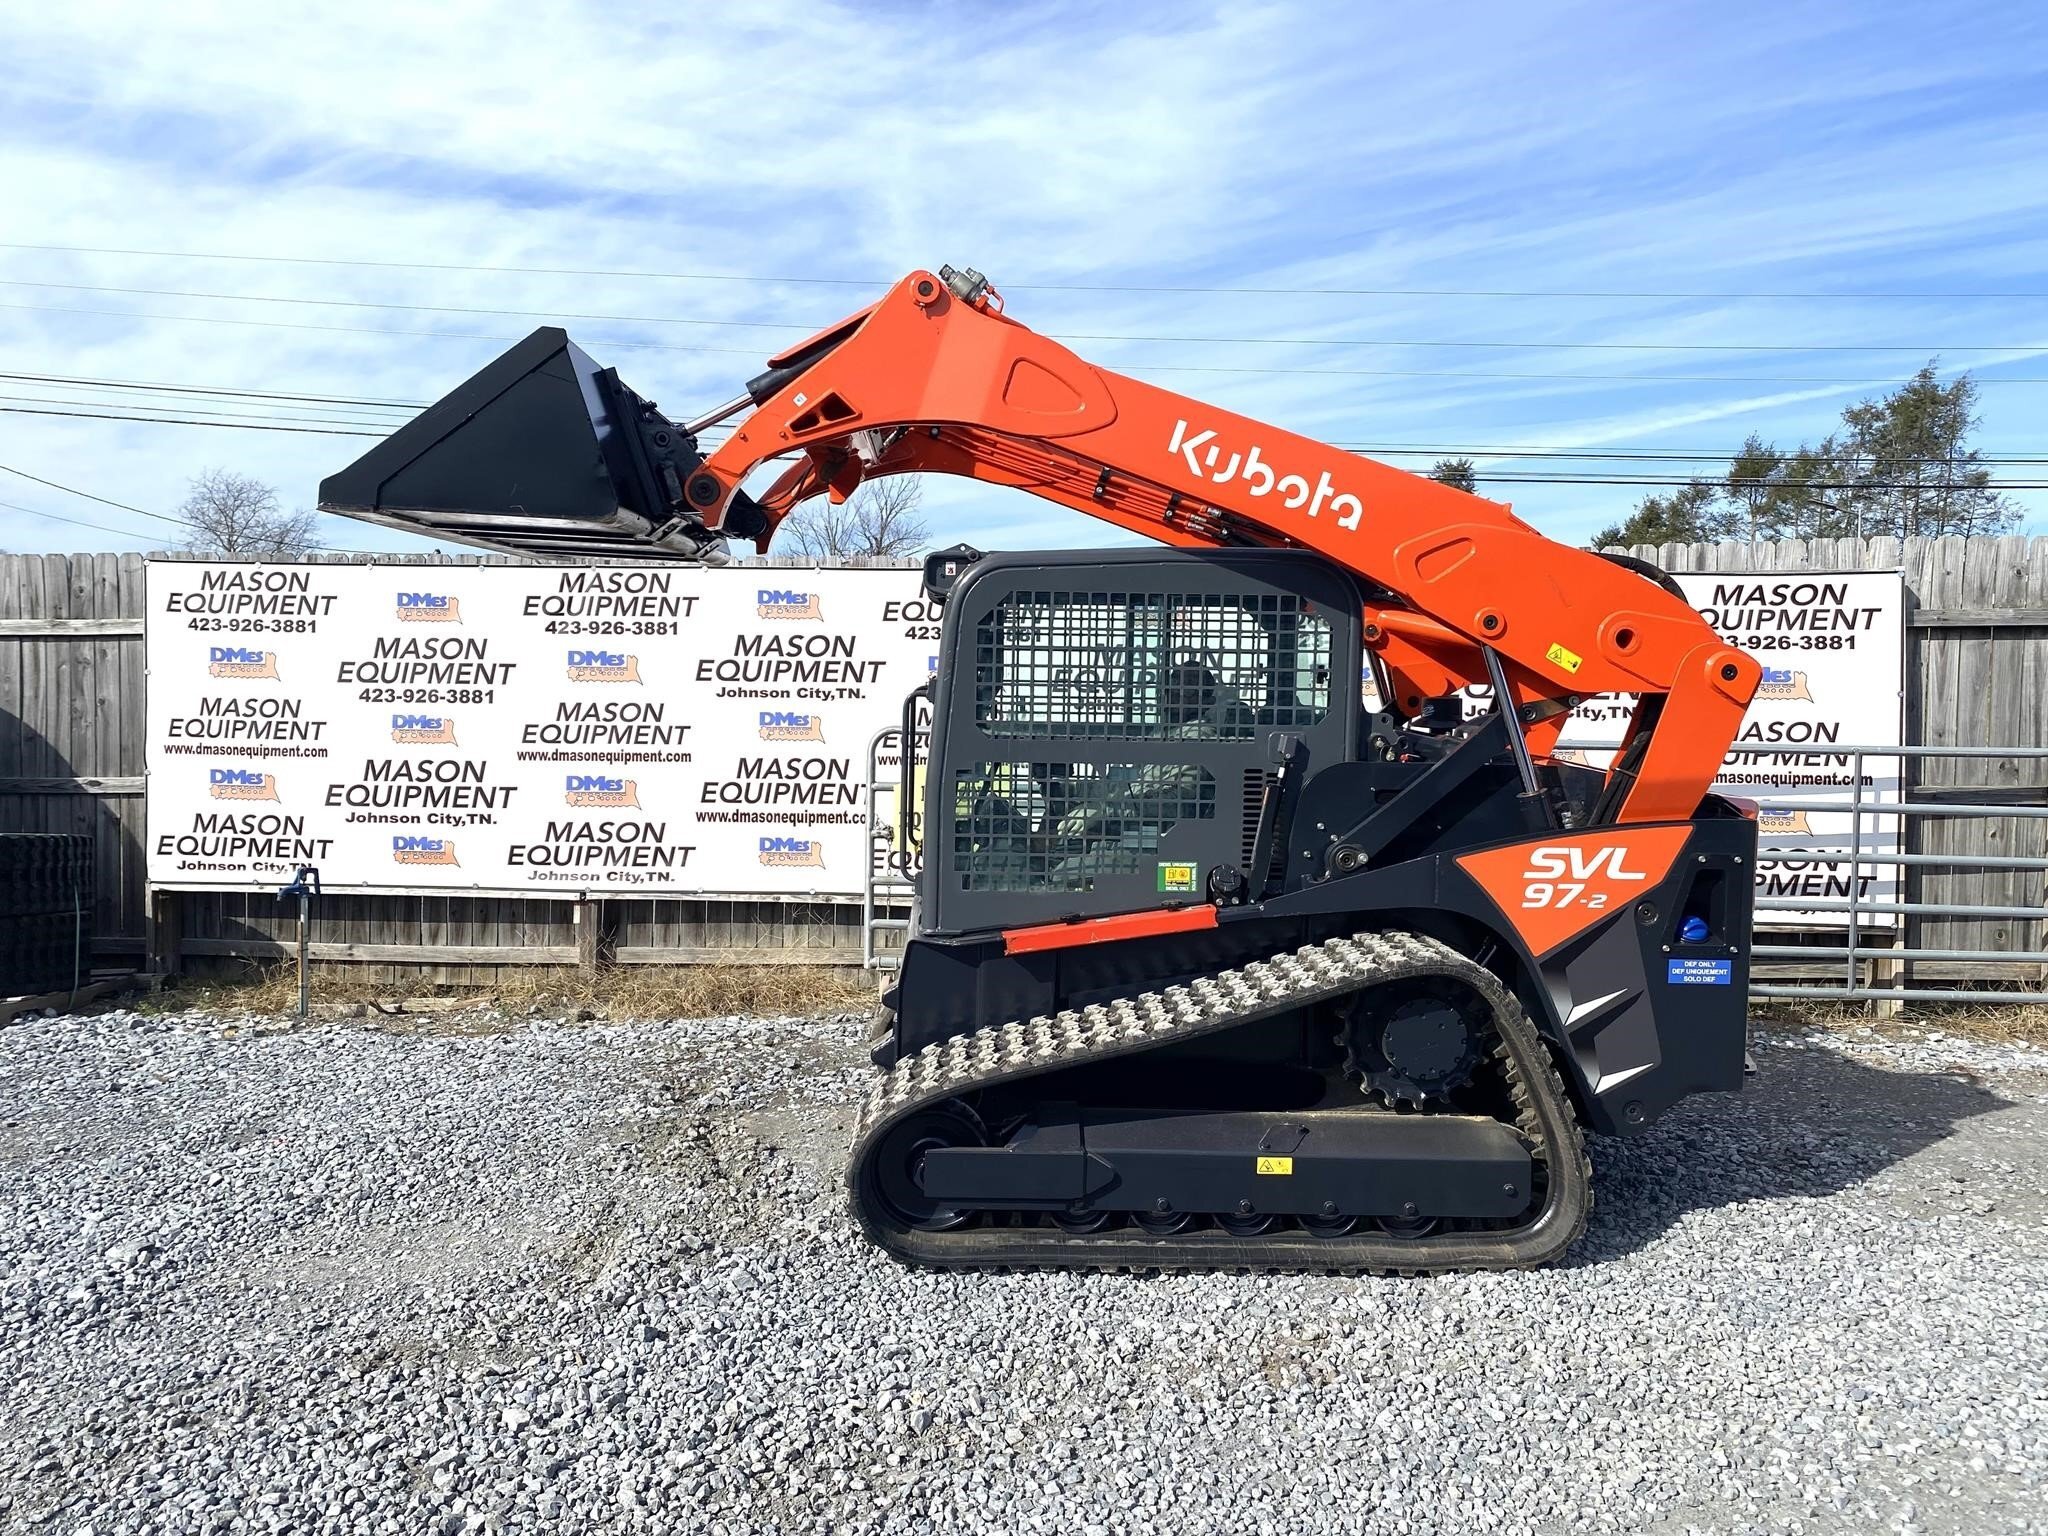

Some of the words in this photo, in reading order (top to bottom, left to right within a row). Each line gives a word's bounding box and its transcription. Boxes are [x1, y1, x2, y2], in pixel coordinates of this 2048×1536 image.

[1167, 419, 1363, 531] Kubota
[201, 571, 310, 592] MASON
[559, 573, 671, 593] MASON
[166, 593, 337, 615] EQUIPMENT
[1713, 584, 1848, 606] MASON
[523, 596, 699, 616] EQUIPMENT
[188, 618, 315, 633] 423-926-3881
[545, 621, 677, 635] 423-926-3881
[1699, 608, 1881, 630] QUIPMENT
[374, 638, 487, 659] MASON
[734, 635, 856, 657] MASON
[1719, 636, 1855, 650] 3-926-3881
[338, 662, 516, 684] EQUIPMENT
[696, 660, 886, 683] EQUIPMENT
[359, 688, 493, 703] 423-926-3881
[716, 687, 790, 698] Johnson
[797, 688, 865, 701] City,TN.
[200, 698, 301, 718] MASON
[556, 703, 664, 722] MASON
[169, 719, 326, 740] EQUIPMENT
[522, 724, 691, 744] EQUIPMENT
[1732, 721, 1840, 743] ASON
[164, 743, 327, 759] www.dmasonequipment.com
[517, 749, 691, 764] www.dmasonequipment.com
[364, 760, 486, 782] MASON
[737, 758, 849, 780] MASON
[325, 785, 517, 808] EQUIPMENT
[700, 782, 866, 805] EQUIPMEN
[193, 814, 304, 835] MASON
[346, 812, 420, 823] Johnson
[427, 813, 496, 826] City,TN.
[696, 810, 866, 827] www.dmasonequipment.co
[545, 822, 666, 843] MASON
[157, 836, 333, 859] EQUIPMENT
[508, 845, 696, 867] EQUIPMENT
[177, 861, 246, 870] Johnson
[1522, 847, 1647, 880] SVL
[1756, 848, 1841, 871] SON
[528, 871, 599, 881] Johnson
[607, 872, 674, 883] City,TN.
[1522, 884, 1608, 909] 97-2
